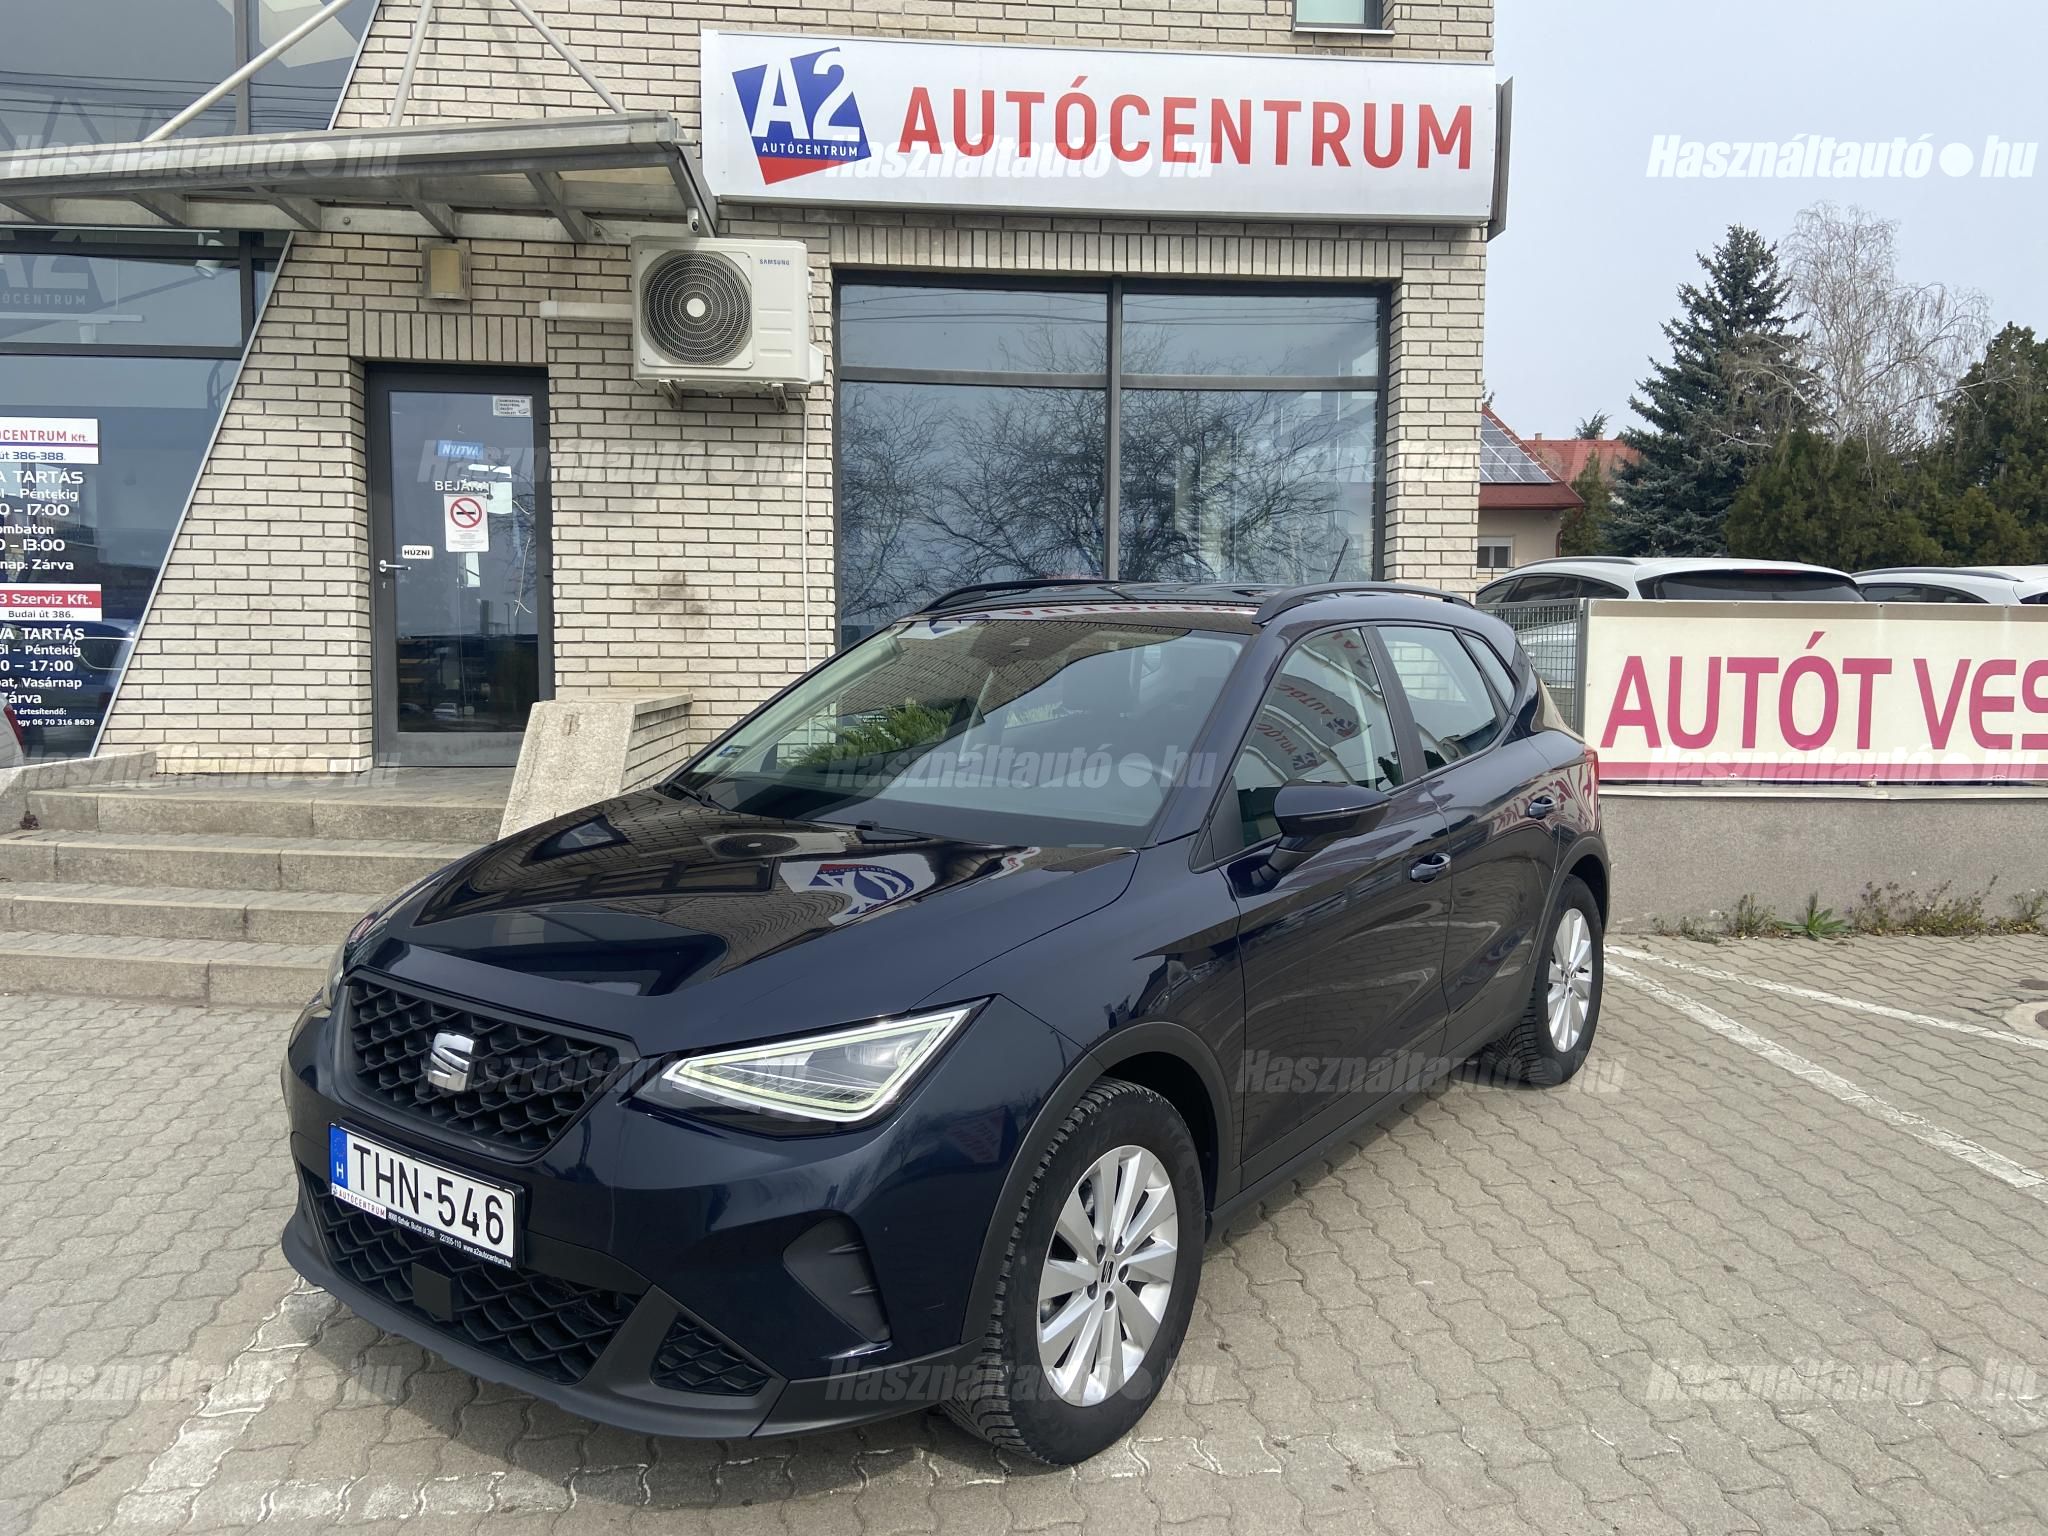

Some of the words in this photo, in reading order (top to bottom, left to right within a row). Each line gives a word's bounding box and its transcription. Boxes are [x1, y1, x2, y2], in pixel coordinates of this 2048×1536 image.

[751, 50, 861, 142] A2
[898, 75, 1473, 170] AUTÓCENTRUM
[761, 142, 858, 157] AUTÓCENTRUM
[759, 258, 790, 266] SAMSUNG
[0, 429, 67, 442] CENTRUM
[12, 468, 84, 485] TARTÁS
[20, 488, 79, 502] Péntekig
[27, 503, 70, 516] 17:00
[23, 538, 65, 551] 13:00
[31, 559, 74, 571] Zárva
[12, 593, 63, 605] Szerviz
[67, 593, 93, 605] Kft.
[8, 610, 36, 618] Budai
[21, 624, 84, 640] TARTÁS
[25, 644, 81, 657] Péntekig
[30, 660, 73, 671] 17:00
[21, 677, 82, 690] Vasárnap
[1601, 631, 1892, 751] AUTÓT
[336, 1161, 344, 1179] H
[353, 1142, 504, 1246] THN-546
